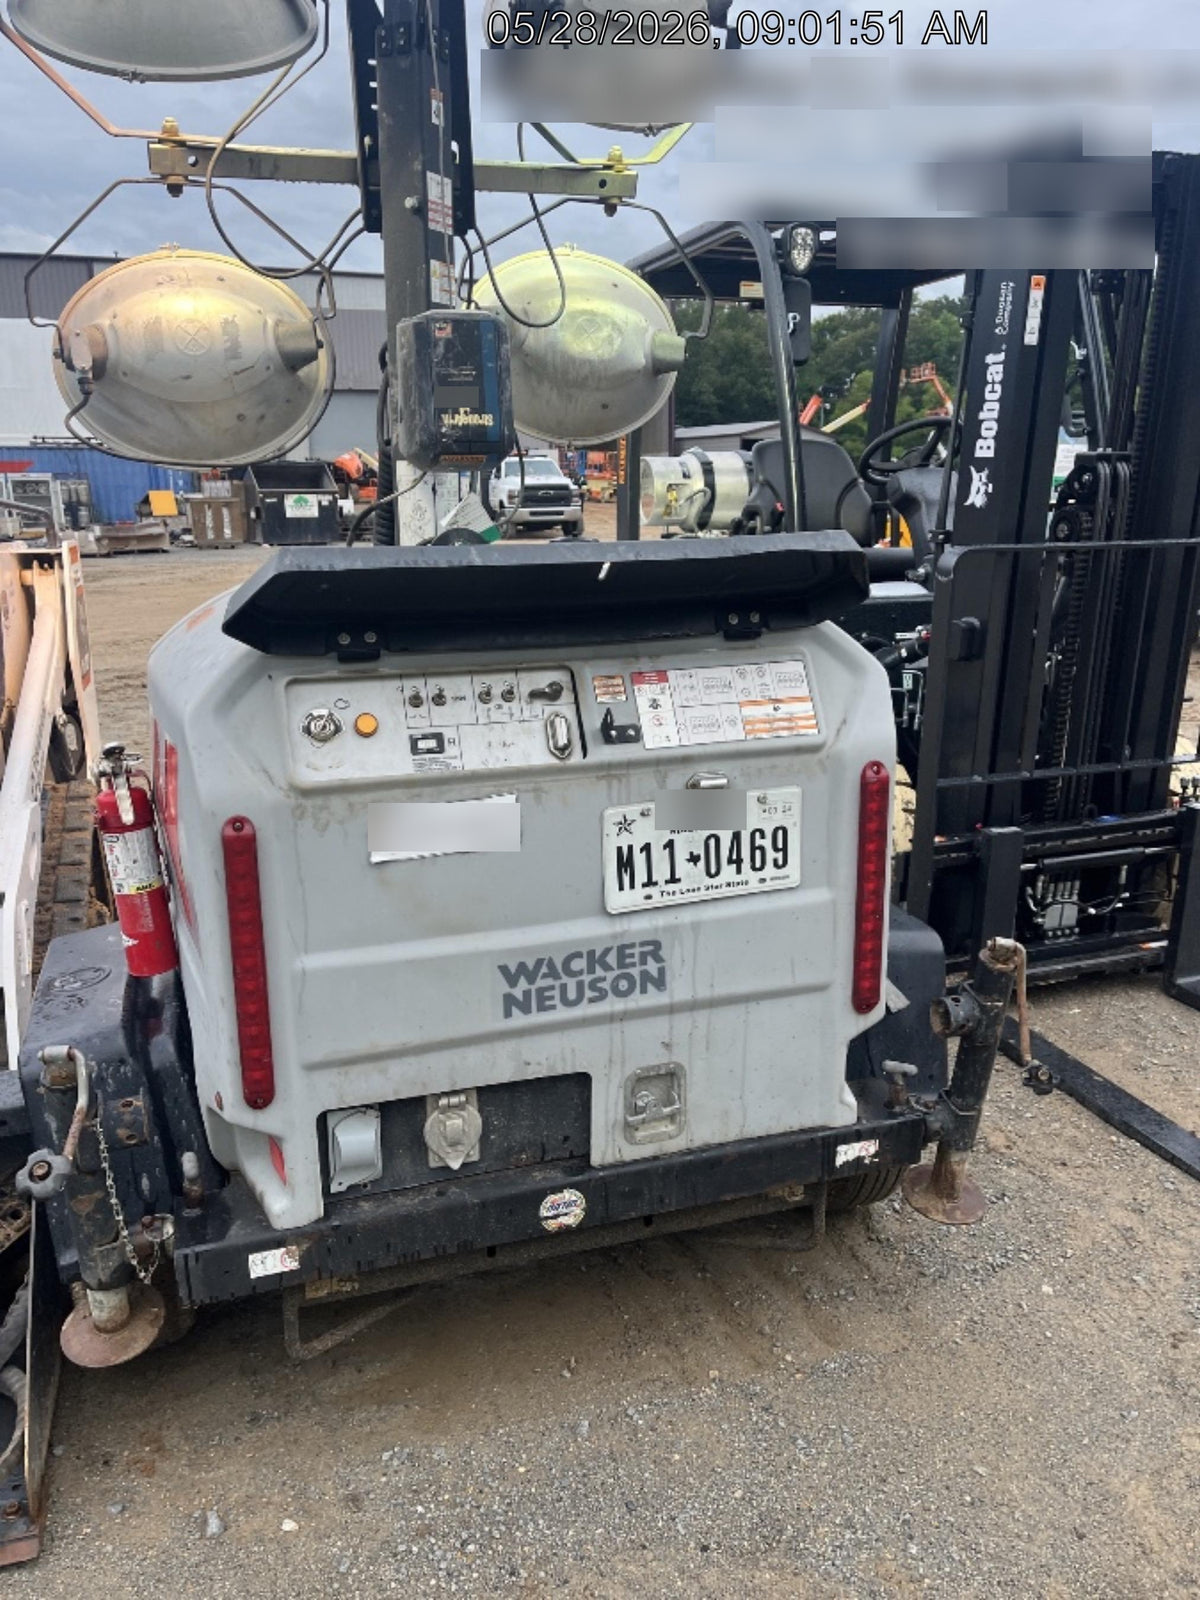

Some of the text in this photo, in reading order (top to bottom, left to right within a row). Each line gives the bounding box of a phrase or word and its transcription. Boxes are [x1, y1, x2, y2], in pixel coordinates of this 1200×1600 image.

[974, 352, 1006, 458] Bobcat
[703, 825, 789, 879] 0469
[497, 939, 666, 989] WACKER
[502, 965, 667, 1020] NEUSON
